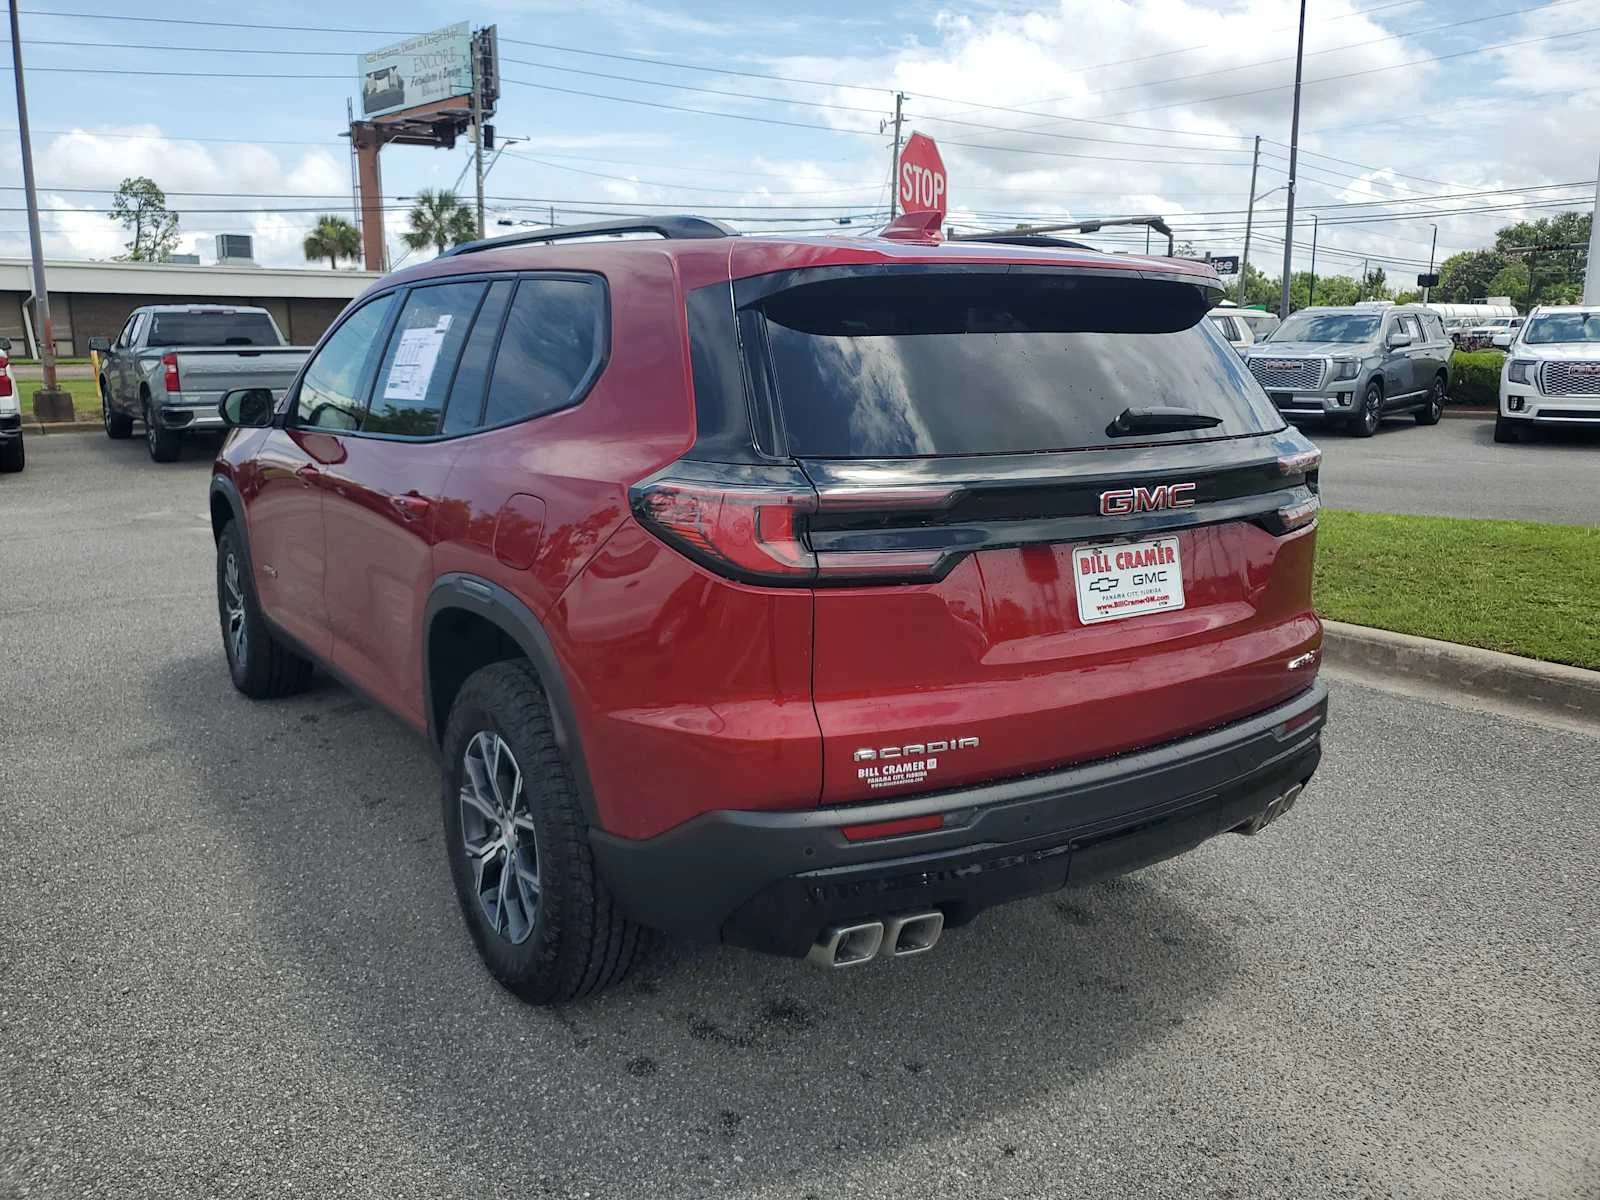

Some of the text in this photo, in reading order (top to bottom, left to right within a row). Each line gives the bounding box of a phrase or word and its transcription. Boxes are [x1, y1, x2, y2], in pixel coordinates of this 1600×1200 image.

[414, 47, 457, 73] ENCORE
[901, 161, 945, 209] STOP
[1099, 482, 1196, 516] GMC
[1080, 546, 1176, 576] BILL CRAMER
[1132, 571, 1168, 586] GMC
[1102, 592, 1126, 602] PANAMA
[1140, 587, 1162, 597] FLORIDA
[854, 736, 980, 762] ACADIA
[858, 767, 880, 779] BILL
[882, 761, 925, 776] CRAMER
[867, 776, 892, 785] PANAMA
[905, 770, 928, 779] FLORIDA
